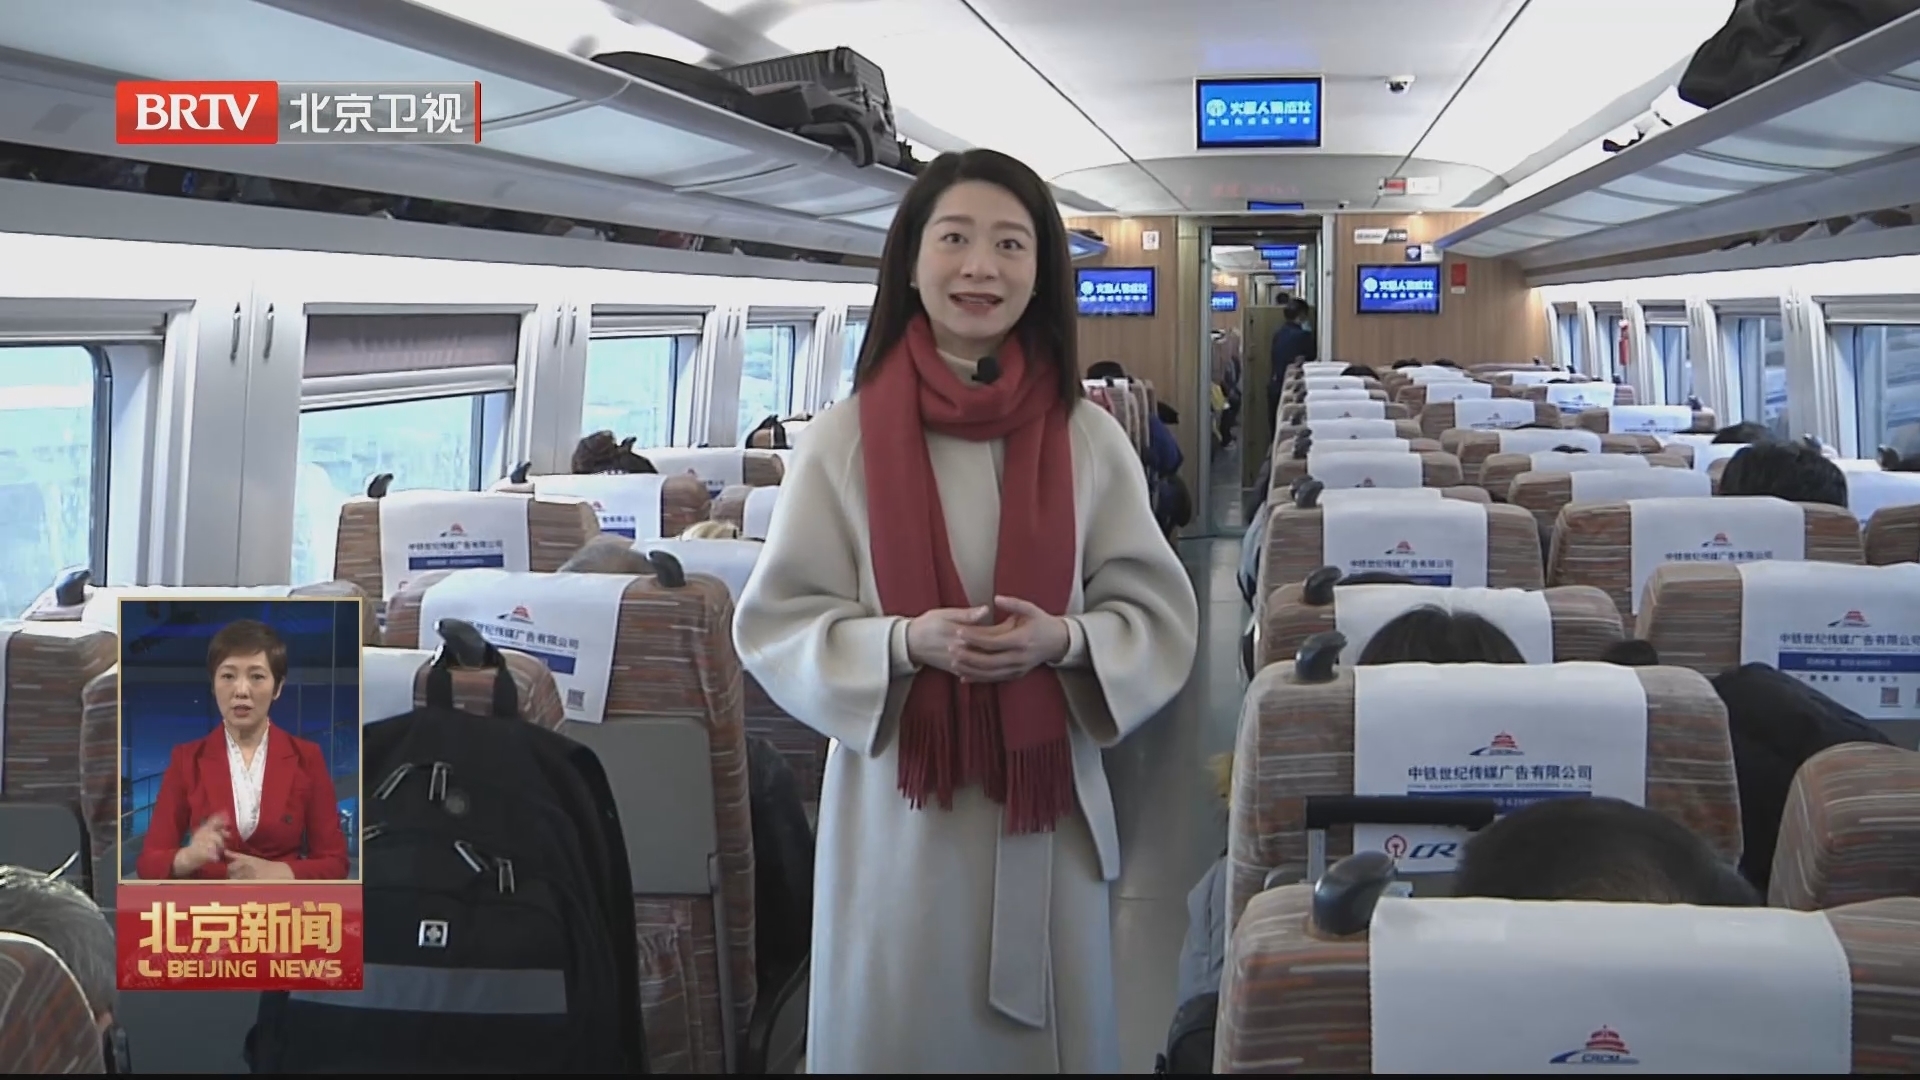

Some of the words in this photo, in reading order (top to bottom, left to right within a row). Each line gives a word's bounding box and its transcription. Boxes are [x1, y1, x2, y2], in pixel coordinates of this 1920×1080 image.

[1407, 764, 1593, 782] 中铁世纪传媒广告有限公司
